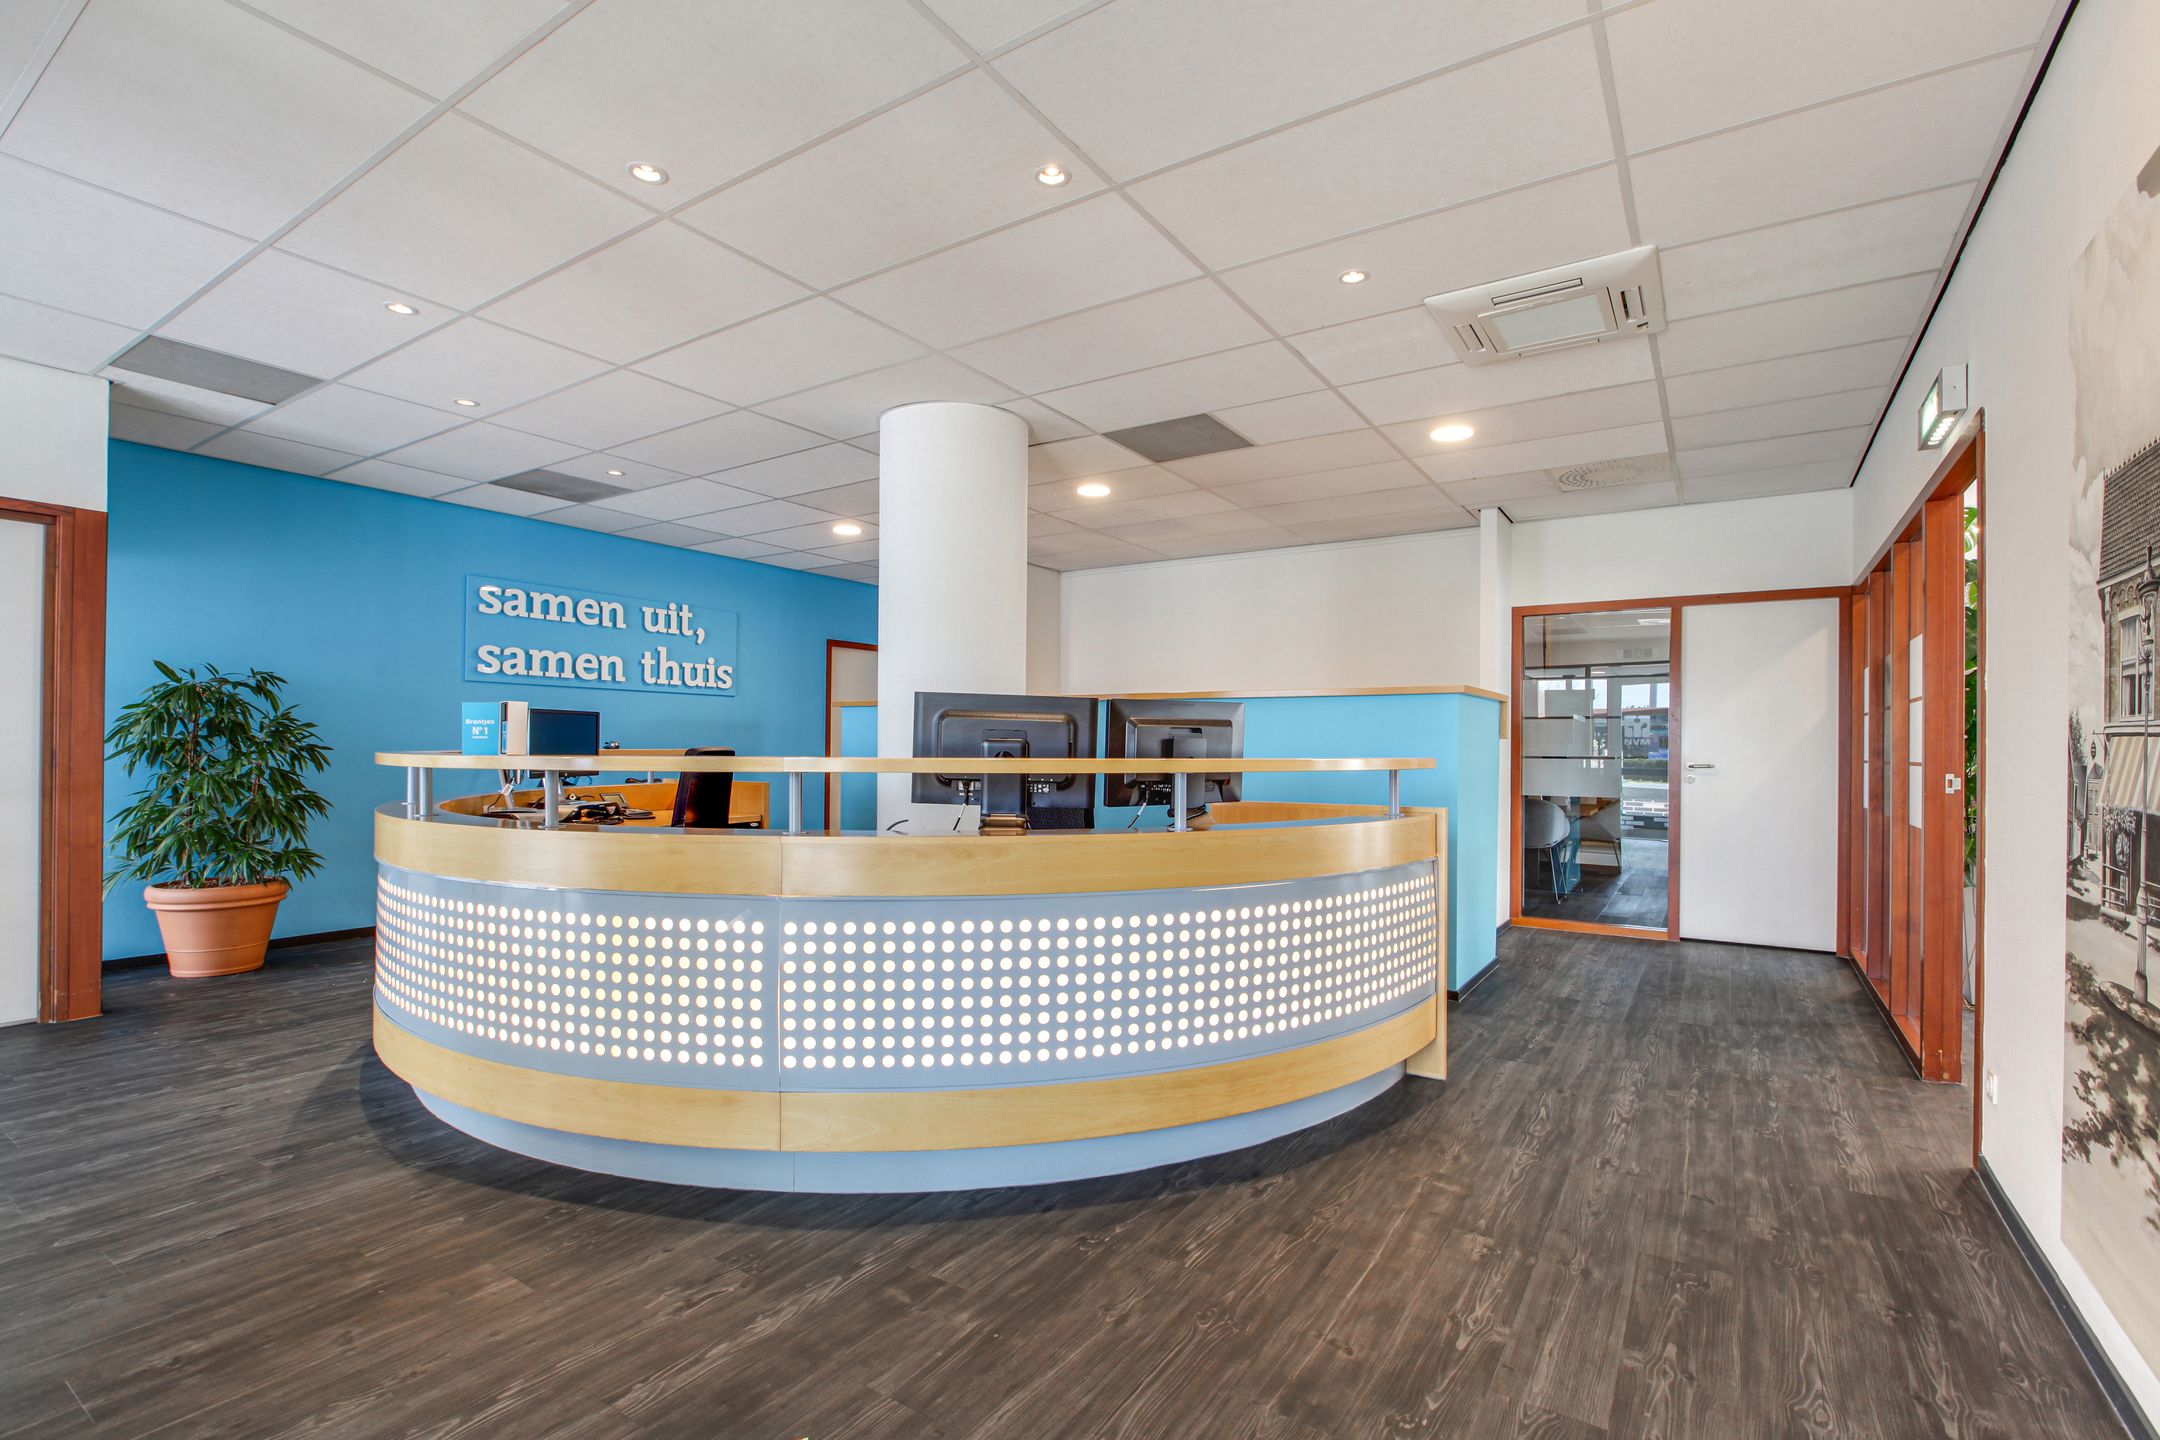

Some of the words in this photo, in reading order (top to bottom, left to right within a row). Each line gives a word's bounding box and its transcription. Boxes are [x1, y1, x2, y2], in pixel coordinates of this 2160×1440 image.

[478, 585, 627, 629] samen
[641, 602, 706, 645] uit,
[477, 644, 626, 682] samen
[640, 646, 733, 689] thuis
